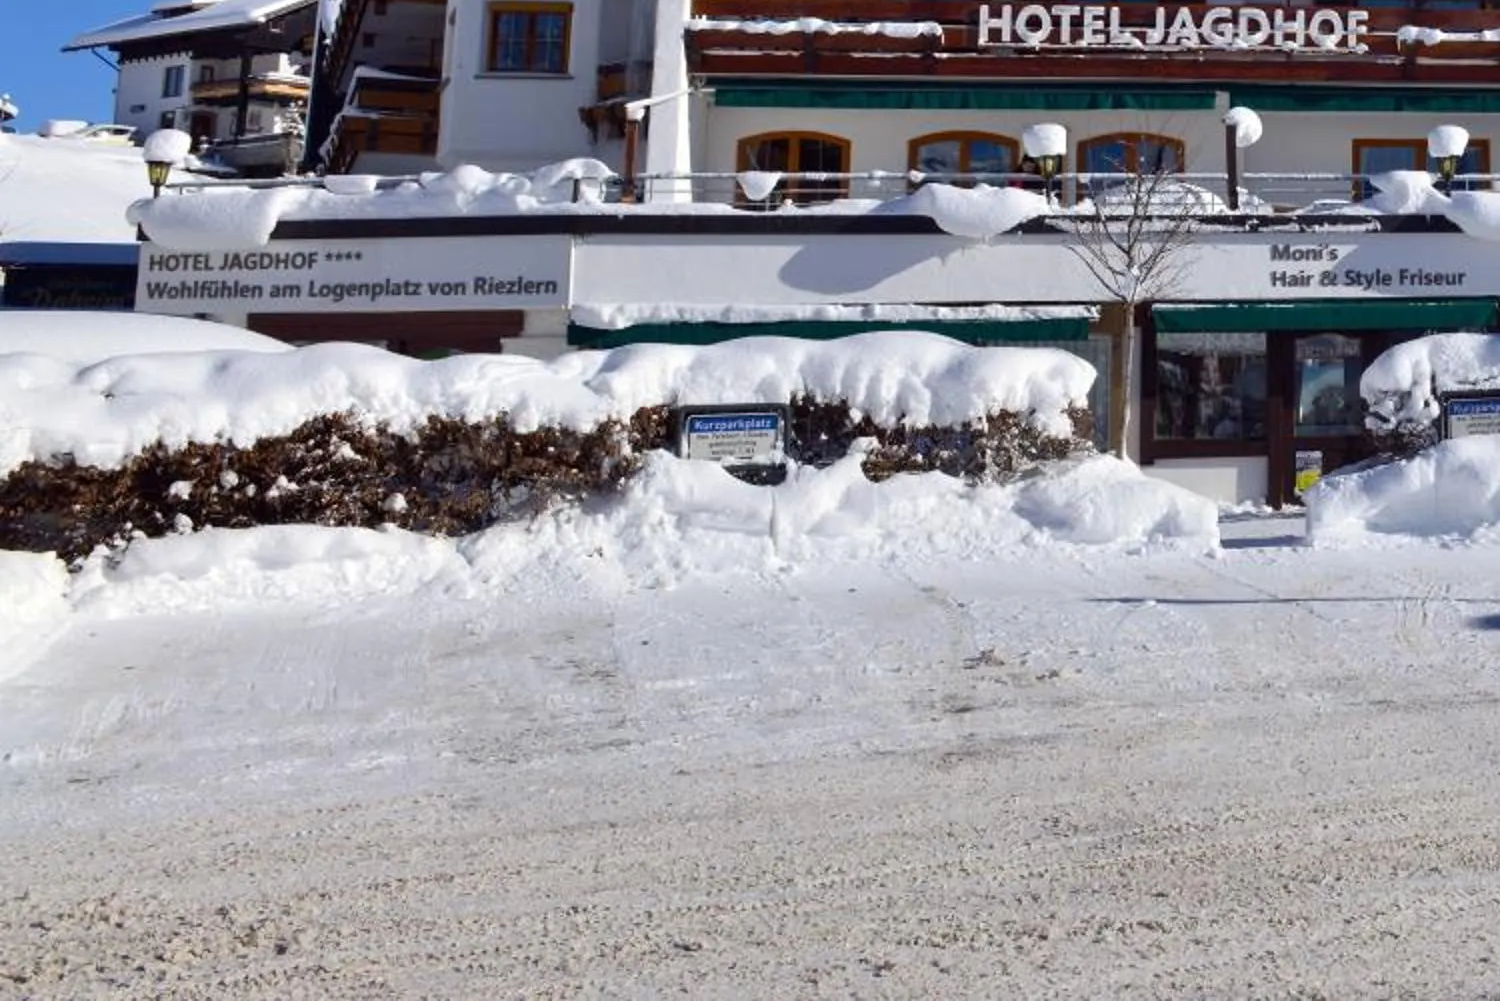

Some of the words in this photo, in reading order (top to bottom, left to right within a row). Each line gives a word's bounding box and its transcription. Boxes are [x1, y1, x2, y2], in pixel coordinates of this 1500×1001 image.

[979, 4, 1137, 46] HOTEL
[1146, 6, 1370, 50] JAGDHOF
[149, 253, 215, 272] HOTEL
[219, 252, 319, 271] JAGDHOF
[1270, 243, 1339, 262] Moni's
[146, 279, 263, 300] Wohlfühlen
[269, 284, 301, 299] am
[308, 277, 423, 302] Logenplatz
[427, 282, 467, 297] von
[473, 275, 558, 296] Riezlern
[1270, 270, 1315, 288] Hair
[1319, 270, 1338, 287] &
[1344, 268, 1393, 291] Style
[1398, 268, 1467, 287] Friseur
[694, 418, 772, 430] Kurzparkplatz
